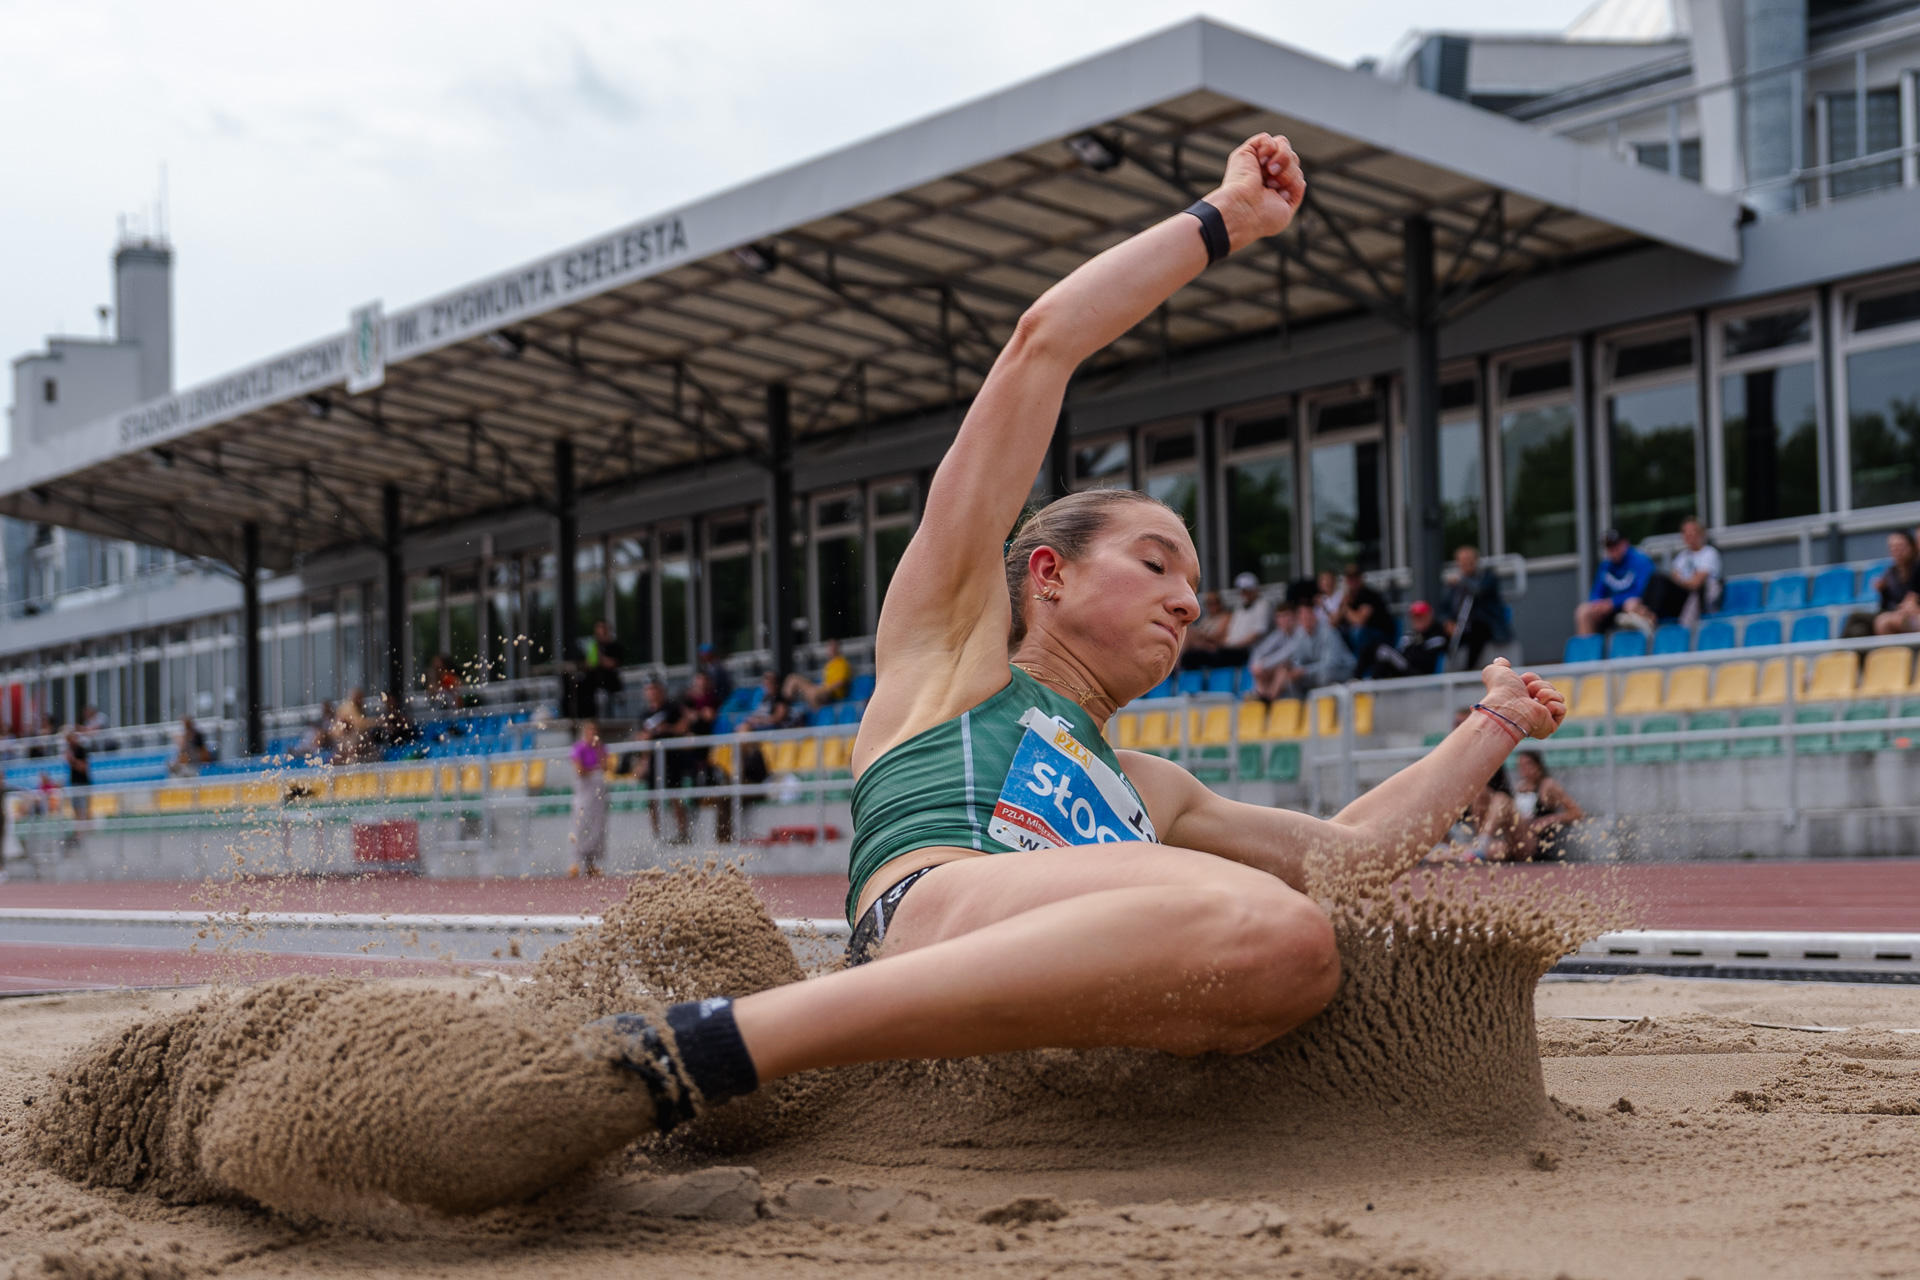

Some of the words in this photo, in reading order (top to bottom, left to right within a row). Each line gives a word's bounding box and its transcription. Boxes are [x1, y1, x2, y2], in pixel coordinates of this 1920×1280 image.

[430, 265, 555, 337] ZYGMUNTA
[564, 217, 688, 290] SZELESTA
[1056, 733, 1088, 765] PZLA
[1001, 807, 1025, 822] PZLA
